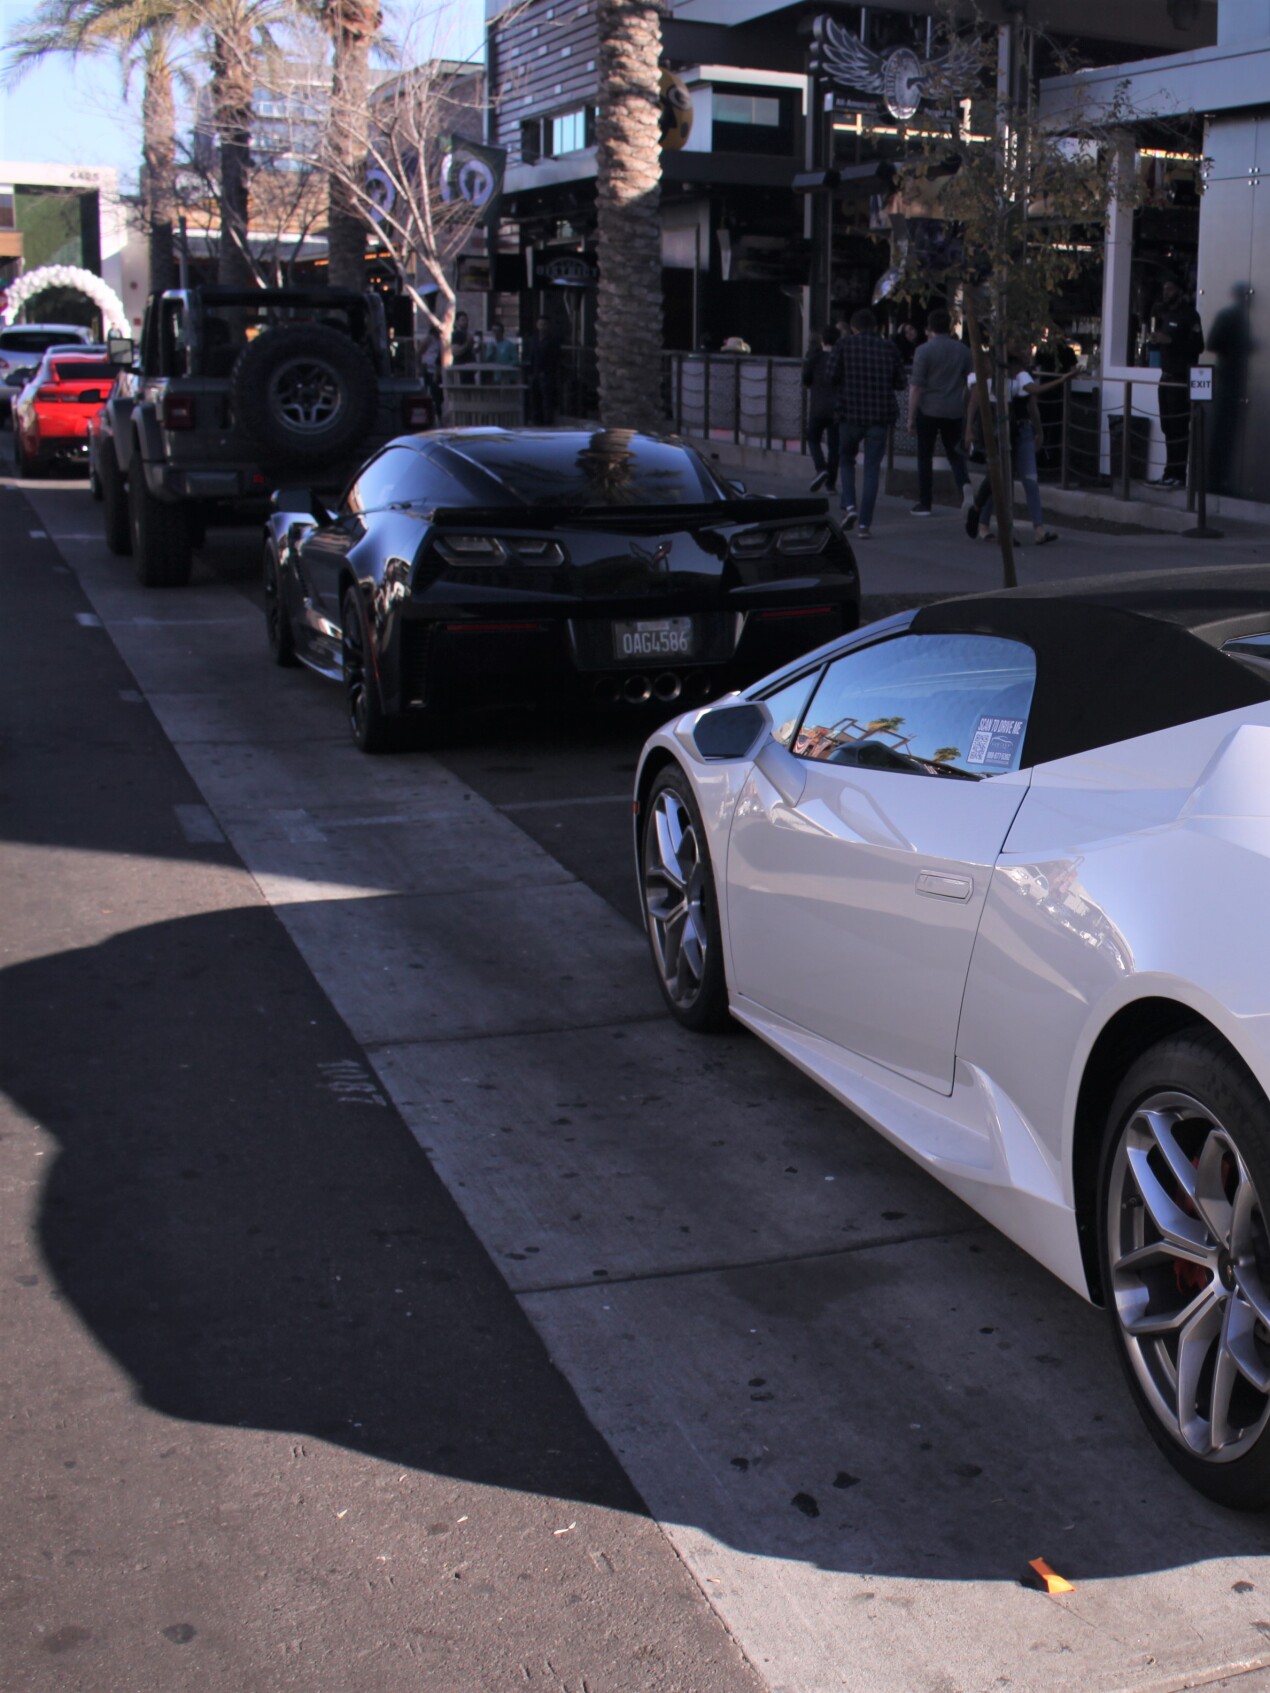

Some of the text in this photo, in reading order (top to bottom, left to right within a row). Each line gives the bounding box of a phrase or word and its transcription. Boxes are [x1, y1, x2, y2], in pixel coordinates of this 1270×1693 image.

[1191, 380, 1211, 388] EXIT
[978, 718, 1023, 735] SCAN TO DRIVE ME
